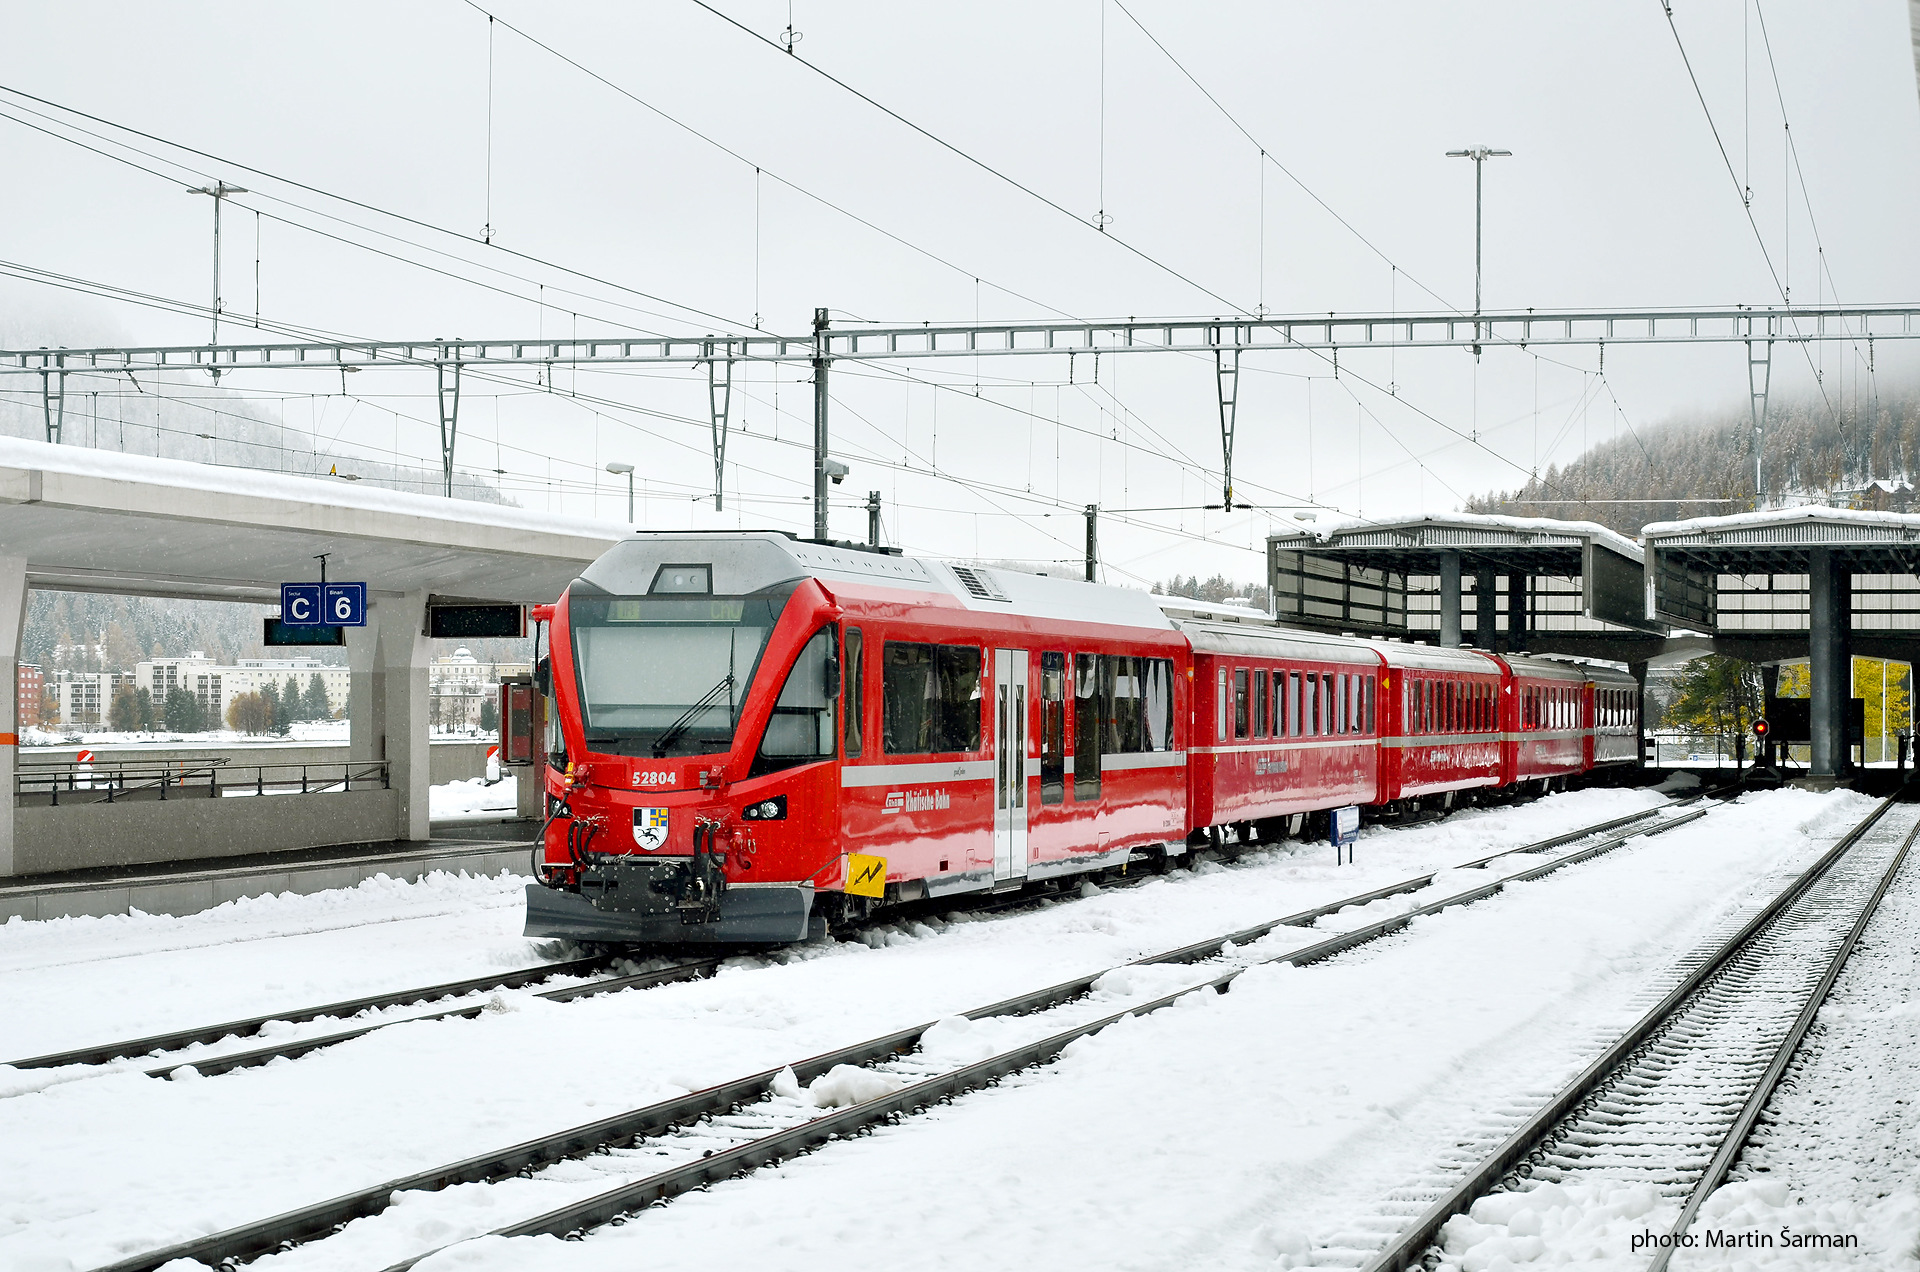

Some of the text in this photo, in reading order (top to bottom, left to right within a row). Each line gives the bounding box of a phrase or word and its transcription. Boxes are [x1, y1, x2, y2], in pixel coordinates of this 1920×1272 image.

[291, 597, 310, 620] C
[335, 596, 351, 619] 6
[983, 646, 989, 678] 2
[1067, 652, 1073, 681] 2
[632, 771, 676, 785] 52804
[935, 787, 950, 810] Bahn
